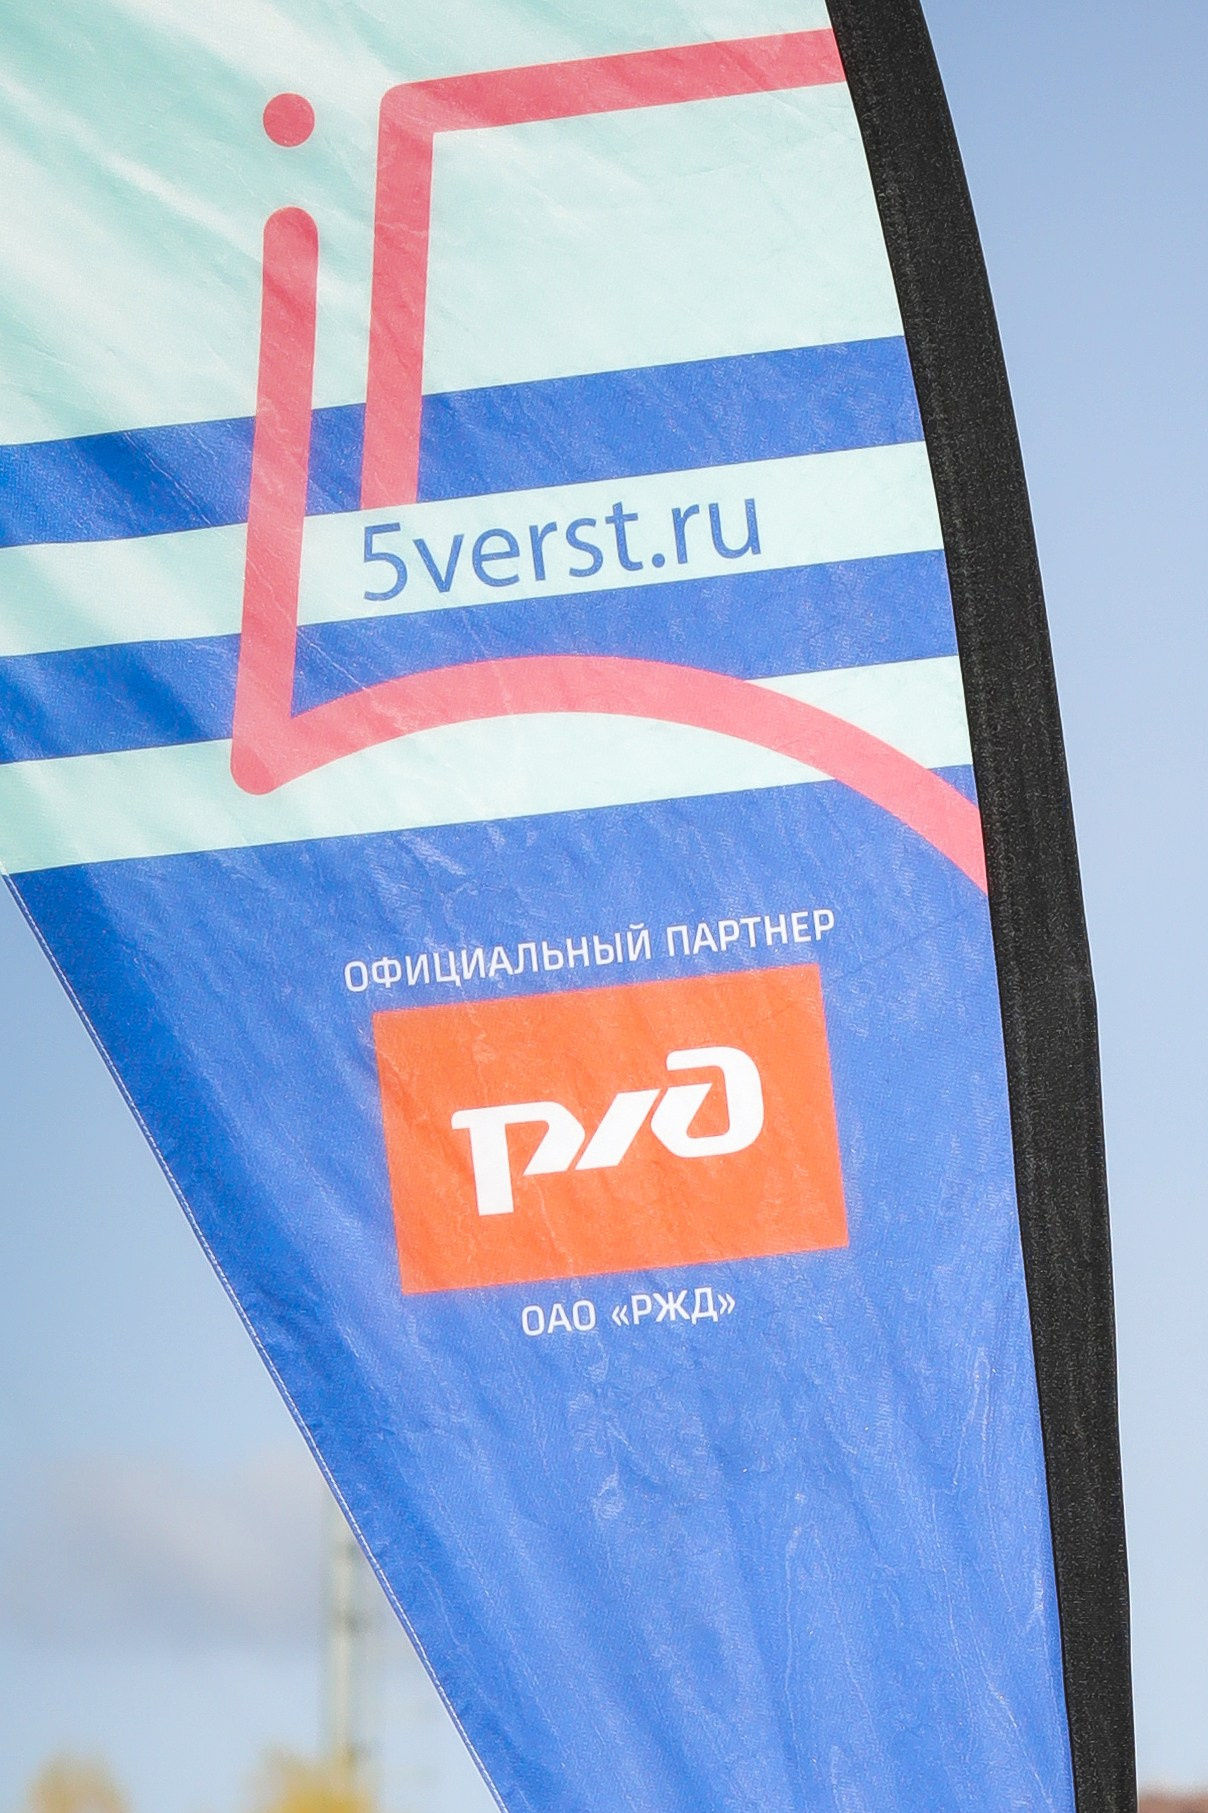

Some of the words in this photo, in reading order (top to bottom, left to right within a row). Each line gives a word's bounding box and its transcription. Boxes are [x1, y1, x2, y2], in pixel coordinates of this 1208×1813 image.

[364, 498, 762, 602] 5verst.ru
[344, 922, 653, 993] ОФИЦИАЛЬНЫЙ
[666, 909, 835, 956] ПАРТНЕР
[521, 1298, 597, 1337] ОАО
[612, 1286, 735, 1328] «РЖД»
